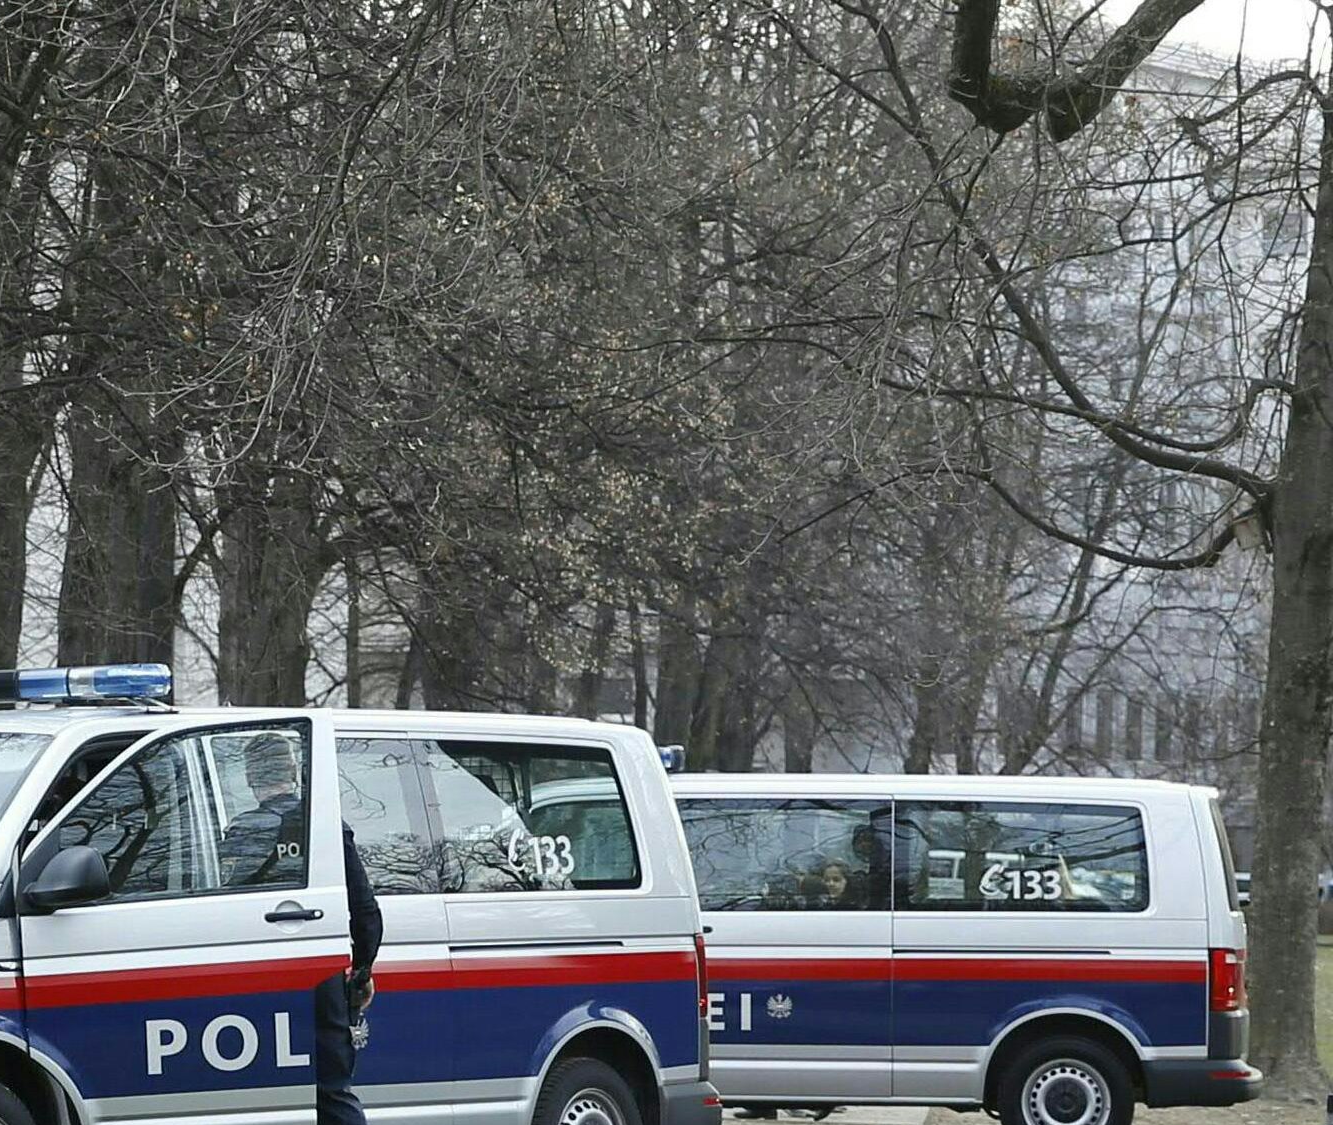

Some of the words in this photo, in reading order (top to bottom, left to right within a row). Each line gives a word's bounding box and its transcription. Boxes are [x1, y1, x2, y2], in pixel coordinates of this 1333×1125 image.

[276, 842, 300, 860] PO
[528, 835, 575, 875] 133
[1003, 870, 1062, 900] 133
[145, 1012, 311, 1075] POL
